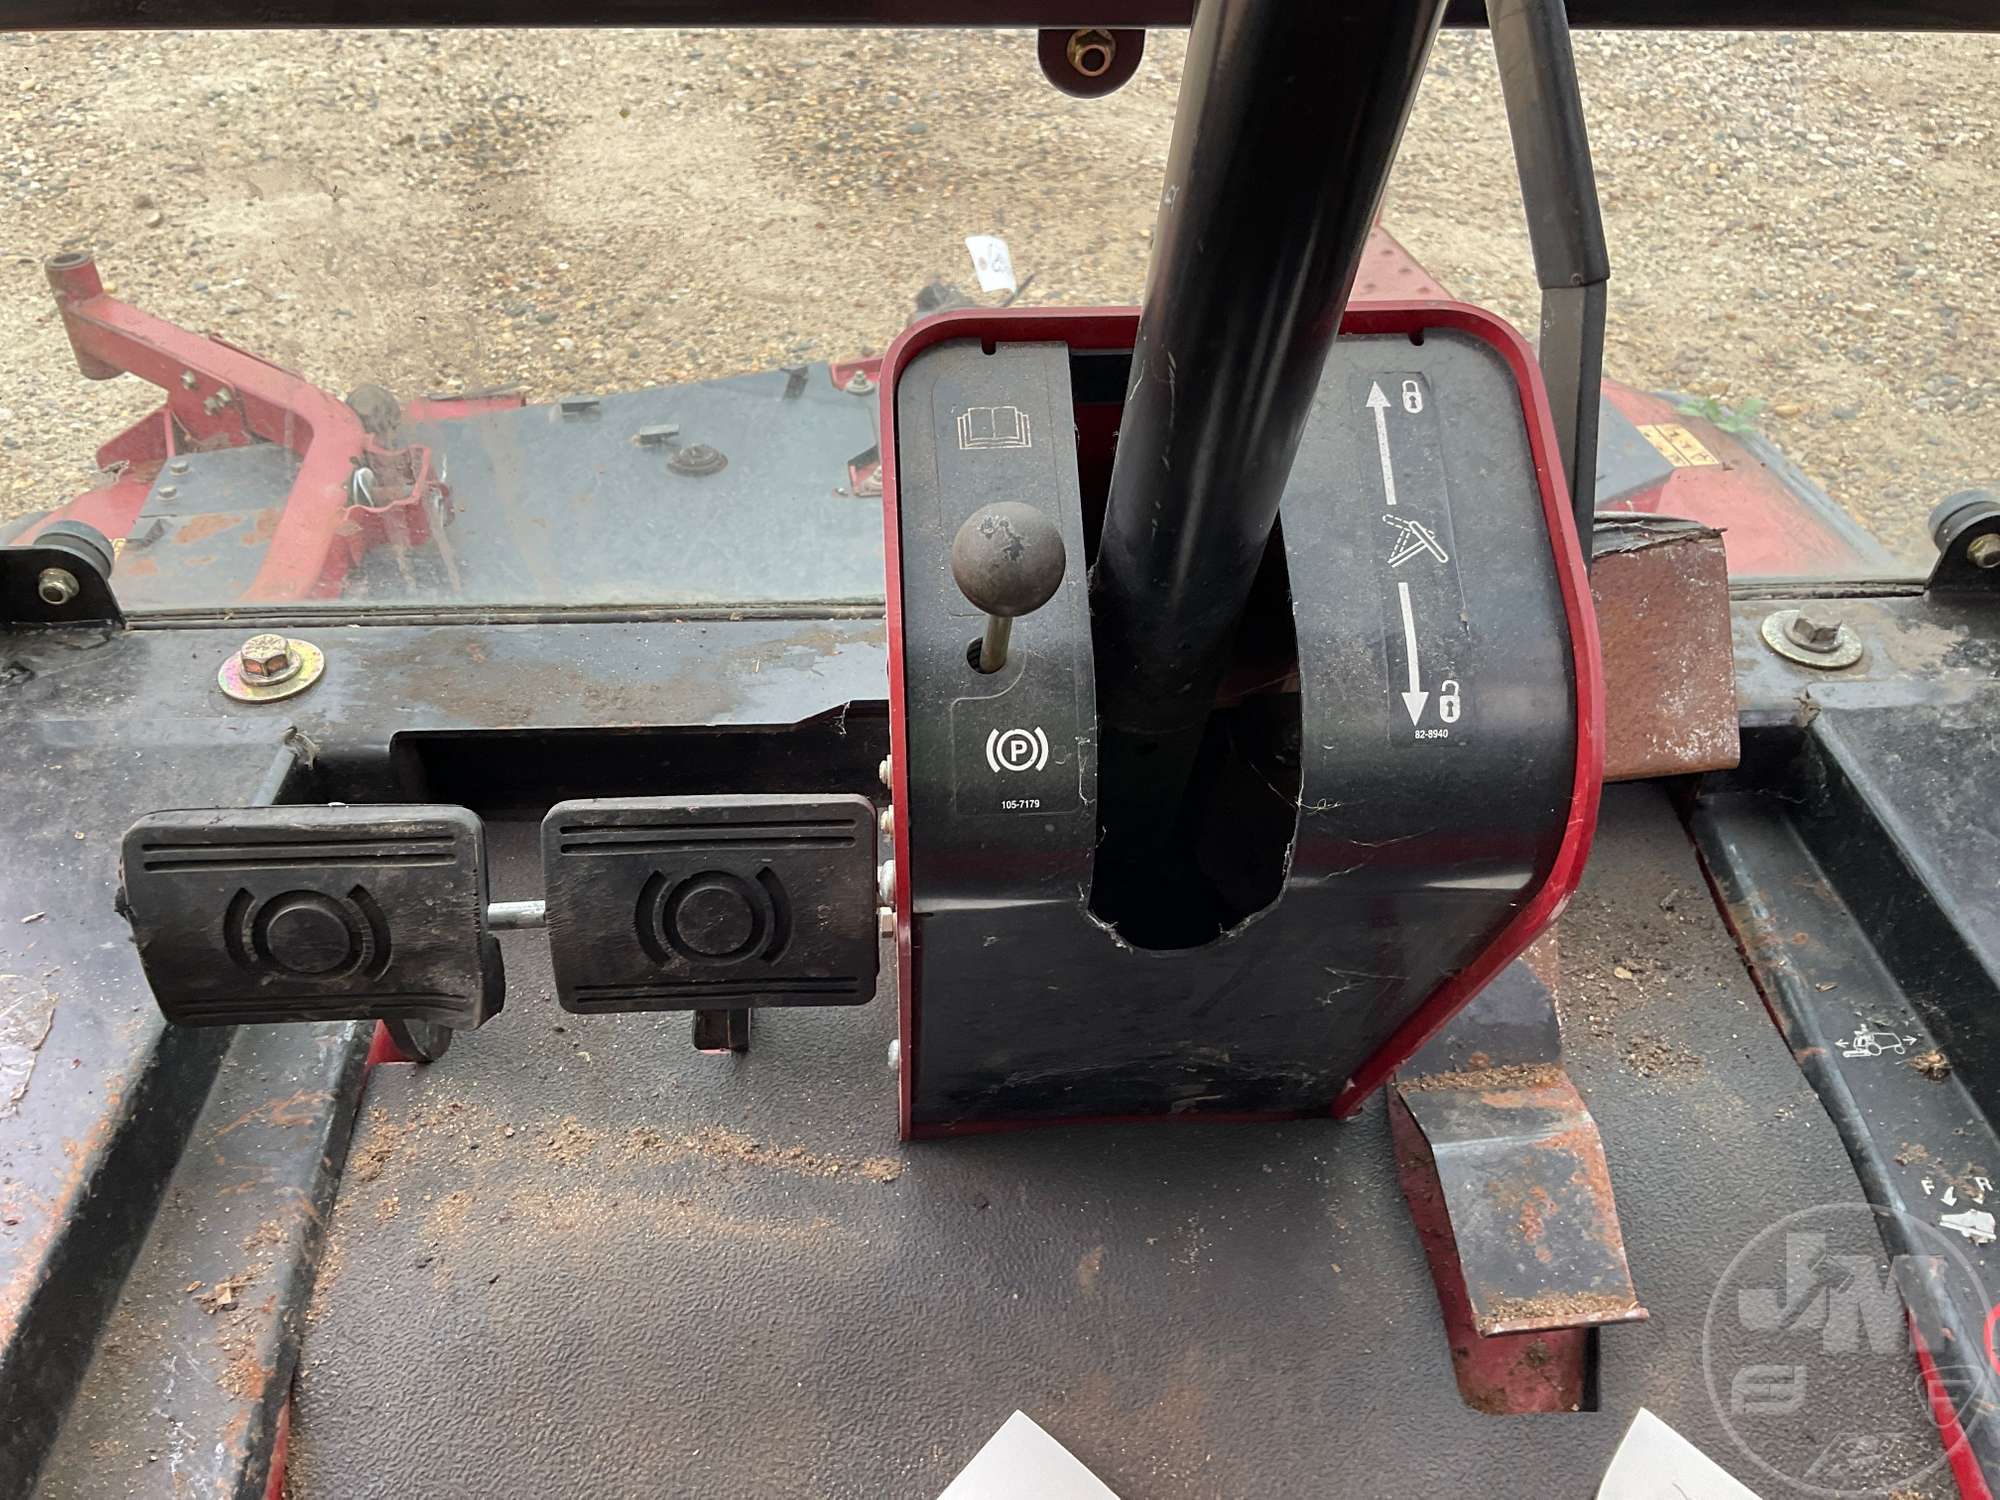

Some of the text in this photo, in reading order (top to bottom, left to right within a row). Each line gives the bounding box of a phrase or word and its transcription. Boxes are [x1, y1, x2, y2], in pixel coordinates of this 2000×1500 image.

[1414, 728, 1449, 739] 82-8940
[1010, 740, 1028, 762] P
[1001, 799, 1040, 809] 105-7179
[1974, 1176, 1993, 1191] R
